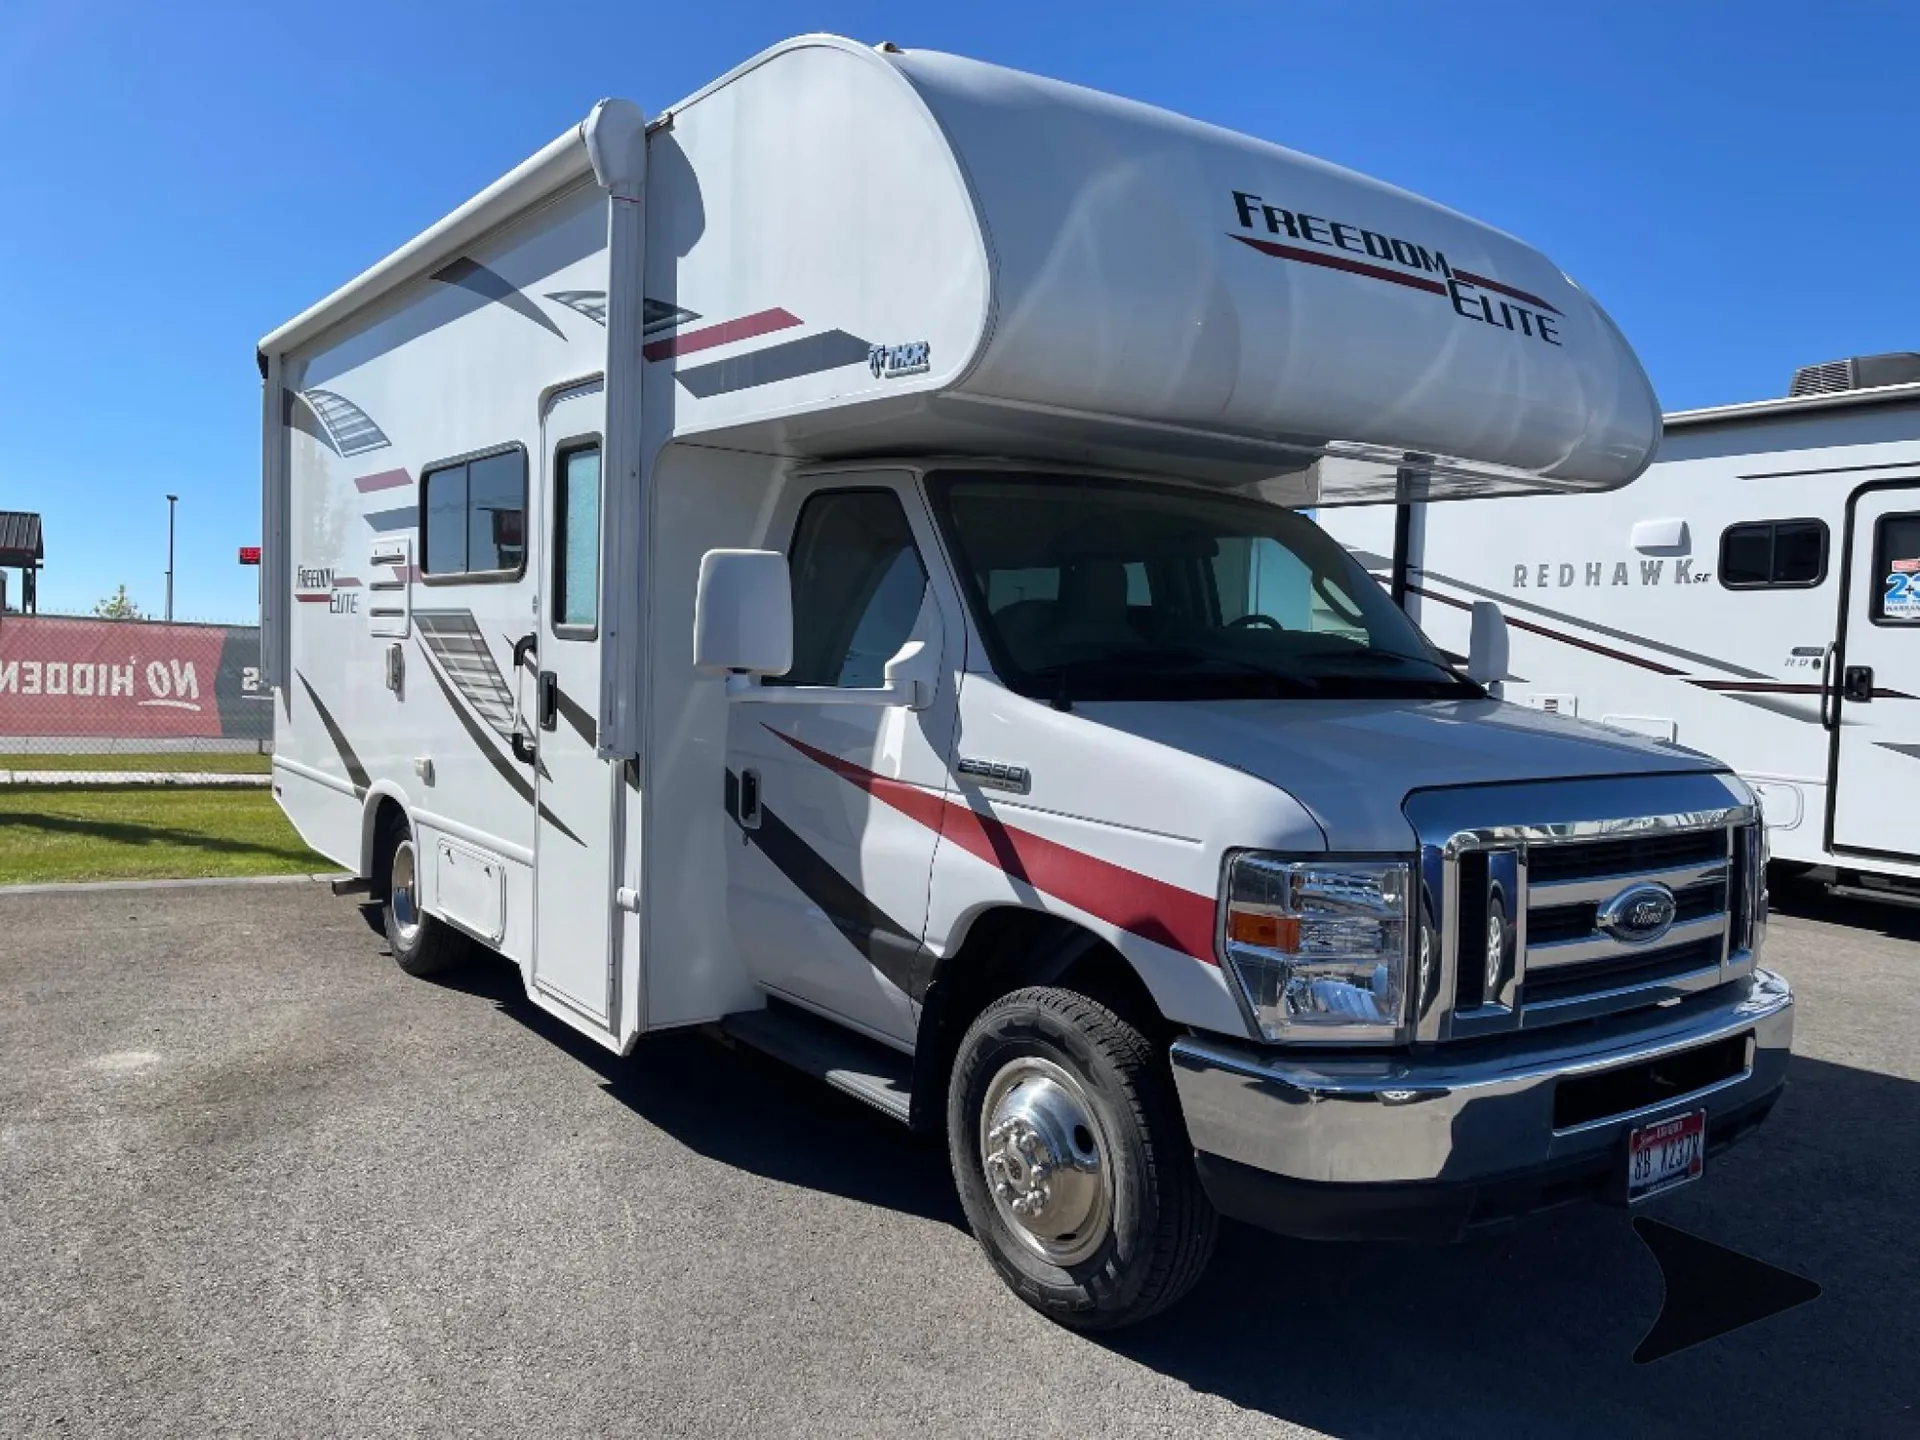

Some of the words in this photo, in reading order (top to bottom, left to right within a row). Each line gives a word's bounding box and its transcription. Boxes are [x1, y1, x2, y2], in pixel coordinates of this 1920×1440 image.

[1231, 190, 1453, 279] FREEDOM
[1447, 278, 1562, 347] ELITE
[1513, 558, 1694, 588] REDHAWK
